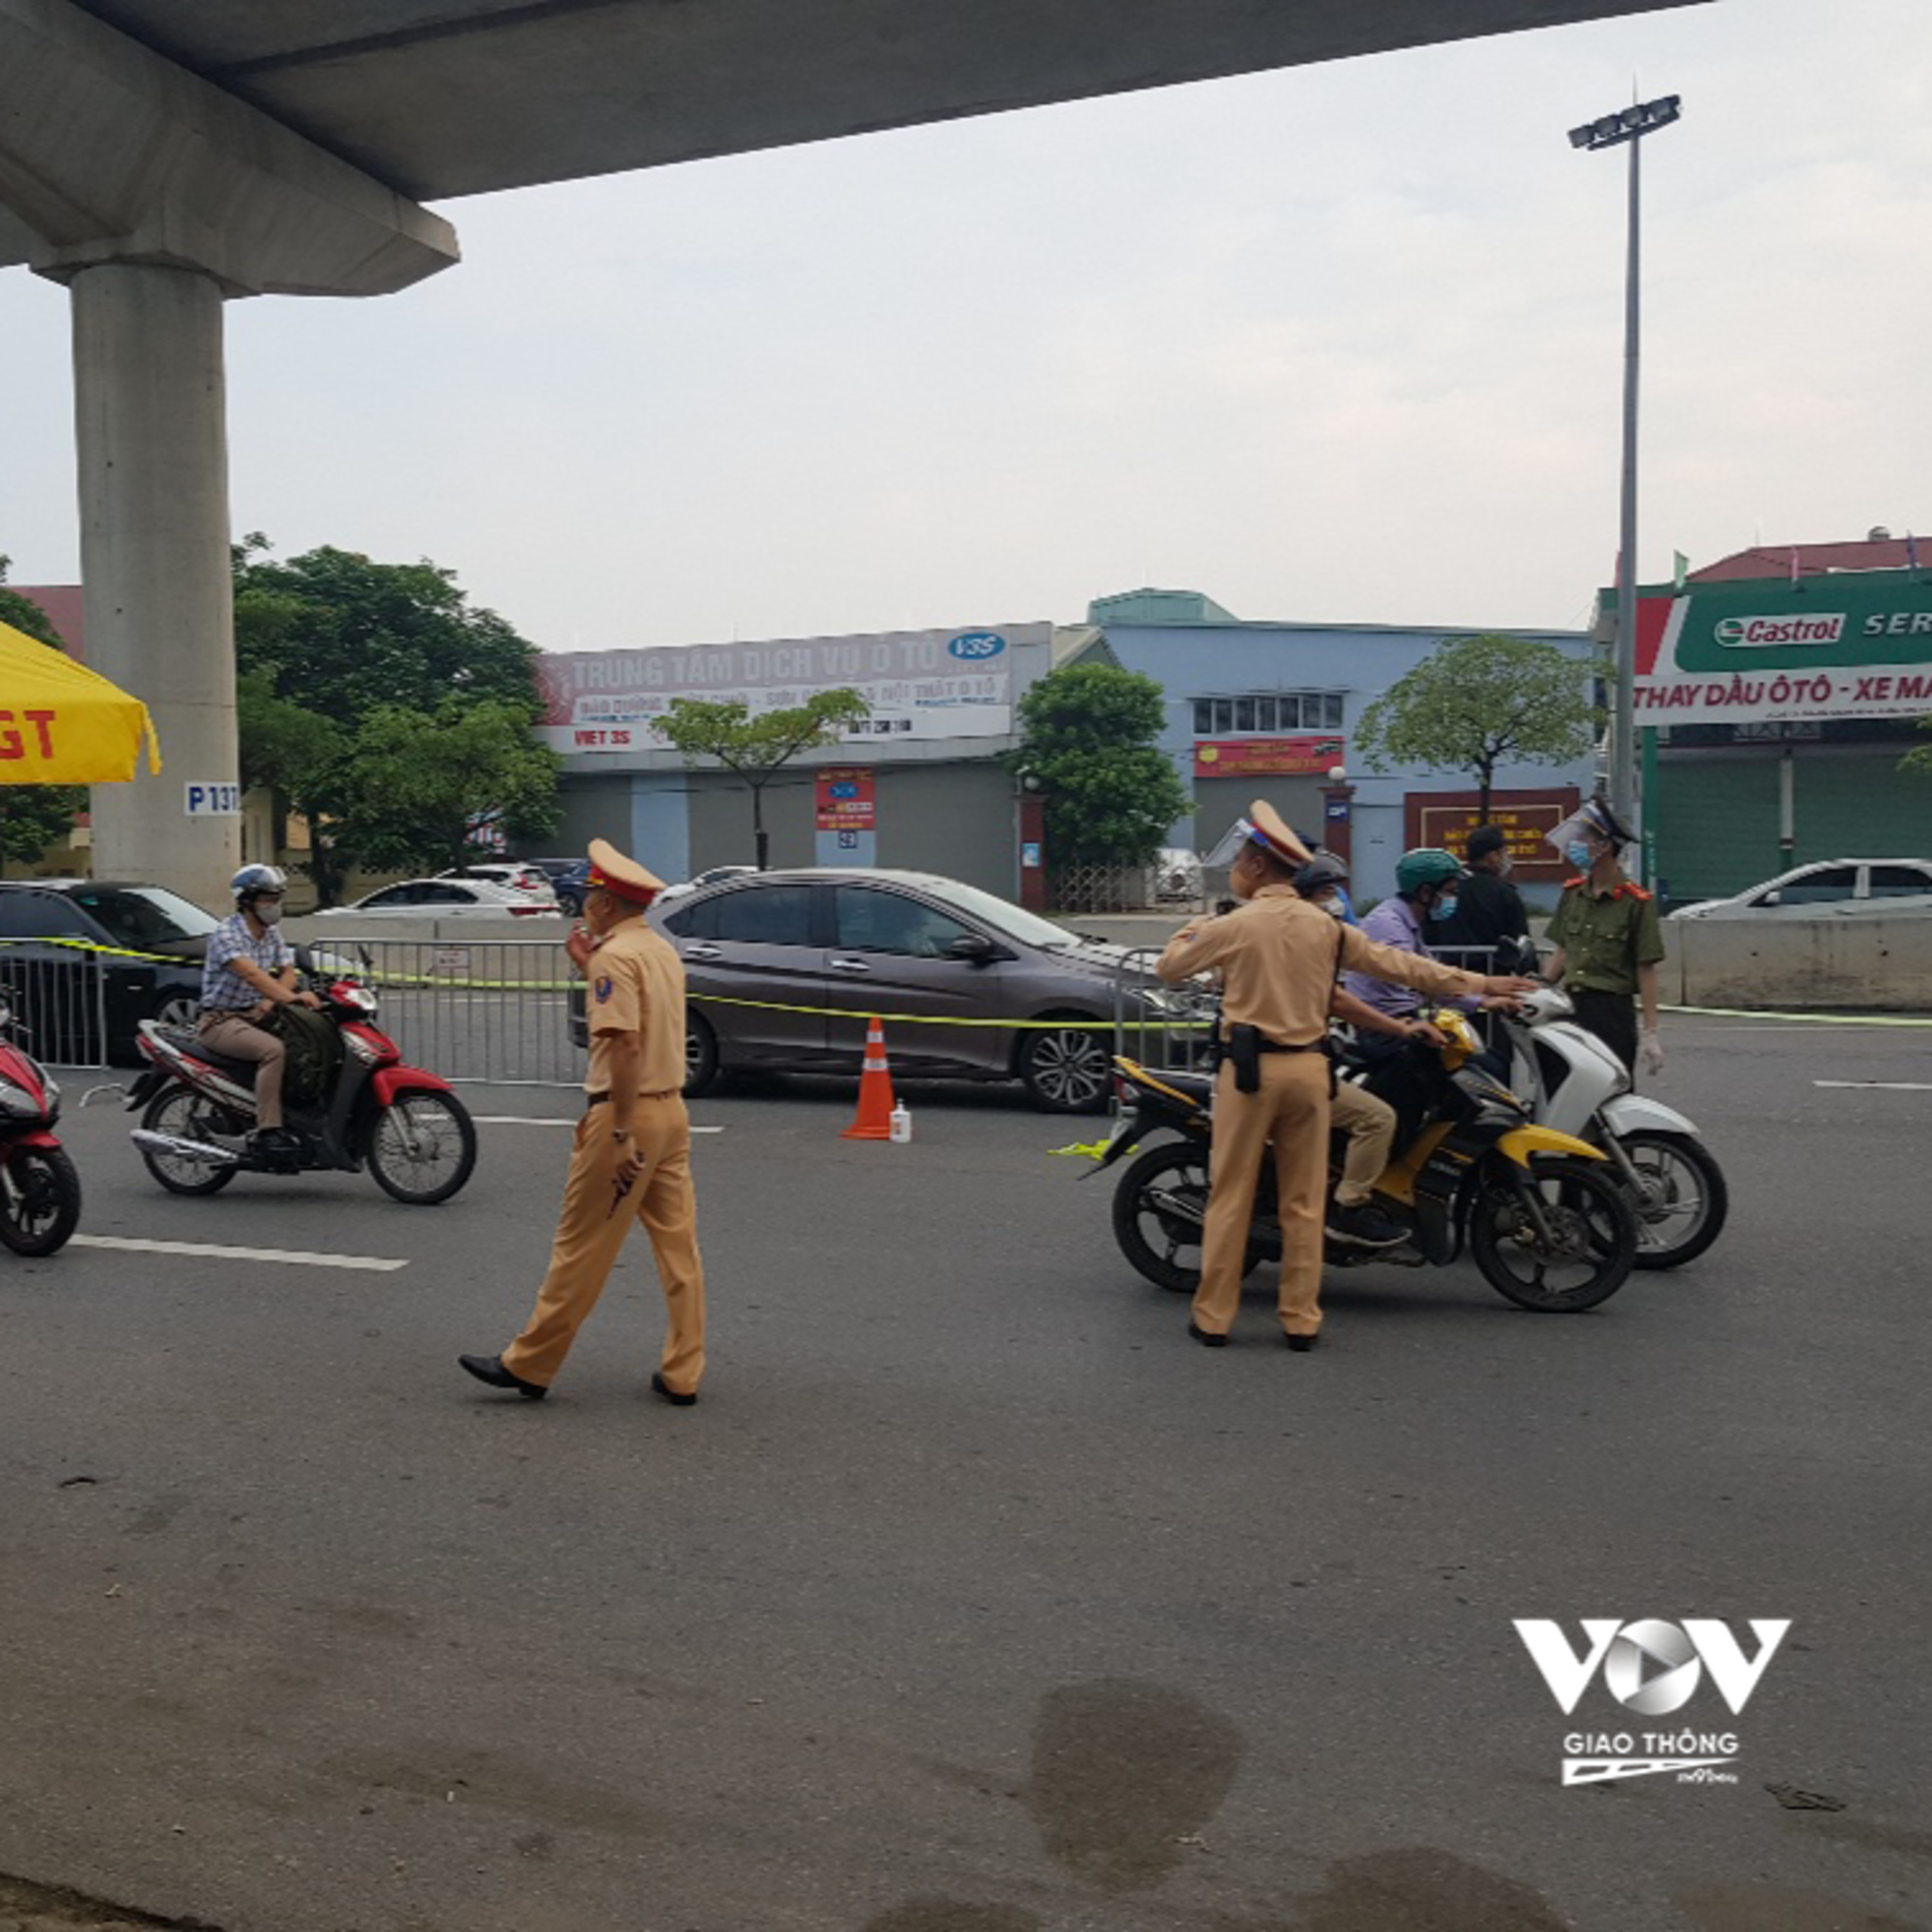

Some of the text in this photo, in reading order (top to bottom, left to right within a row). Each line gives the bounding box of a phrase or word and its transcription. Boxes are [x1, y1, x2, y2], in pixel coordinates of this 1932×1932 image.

[1746, 612, 1932, 643] Castrol SER
[573, 656, 664, 688] TRUNG
[672, 648, 733, 683] TÂM
[744, 646, 811, 687] DỊCH
[900, 633, 939, 670] TÔ
[1633, 685, 1704, 708] THAY
[1705, 674, 1765, 707] DẦU
[1768, 675, 1831, 704] ÔTÔ
[1852, 676, 1892, 701] XE
